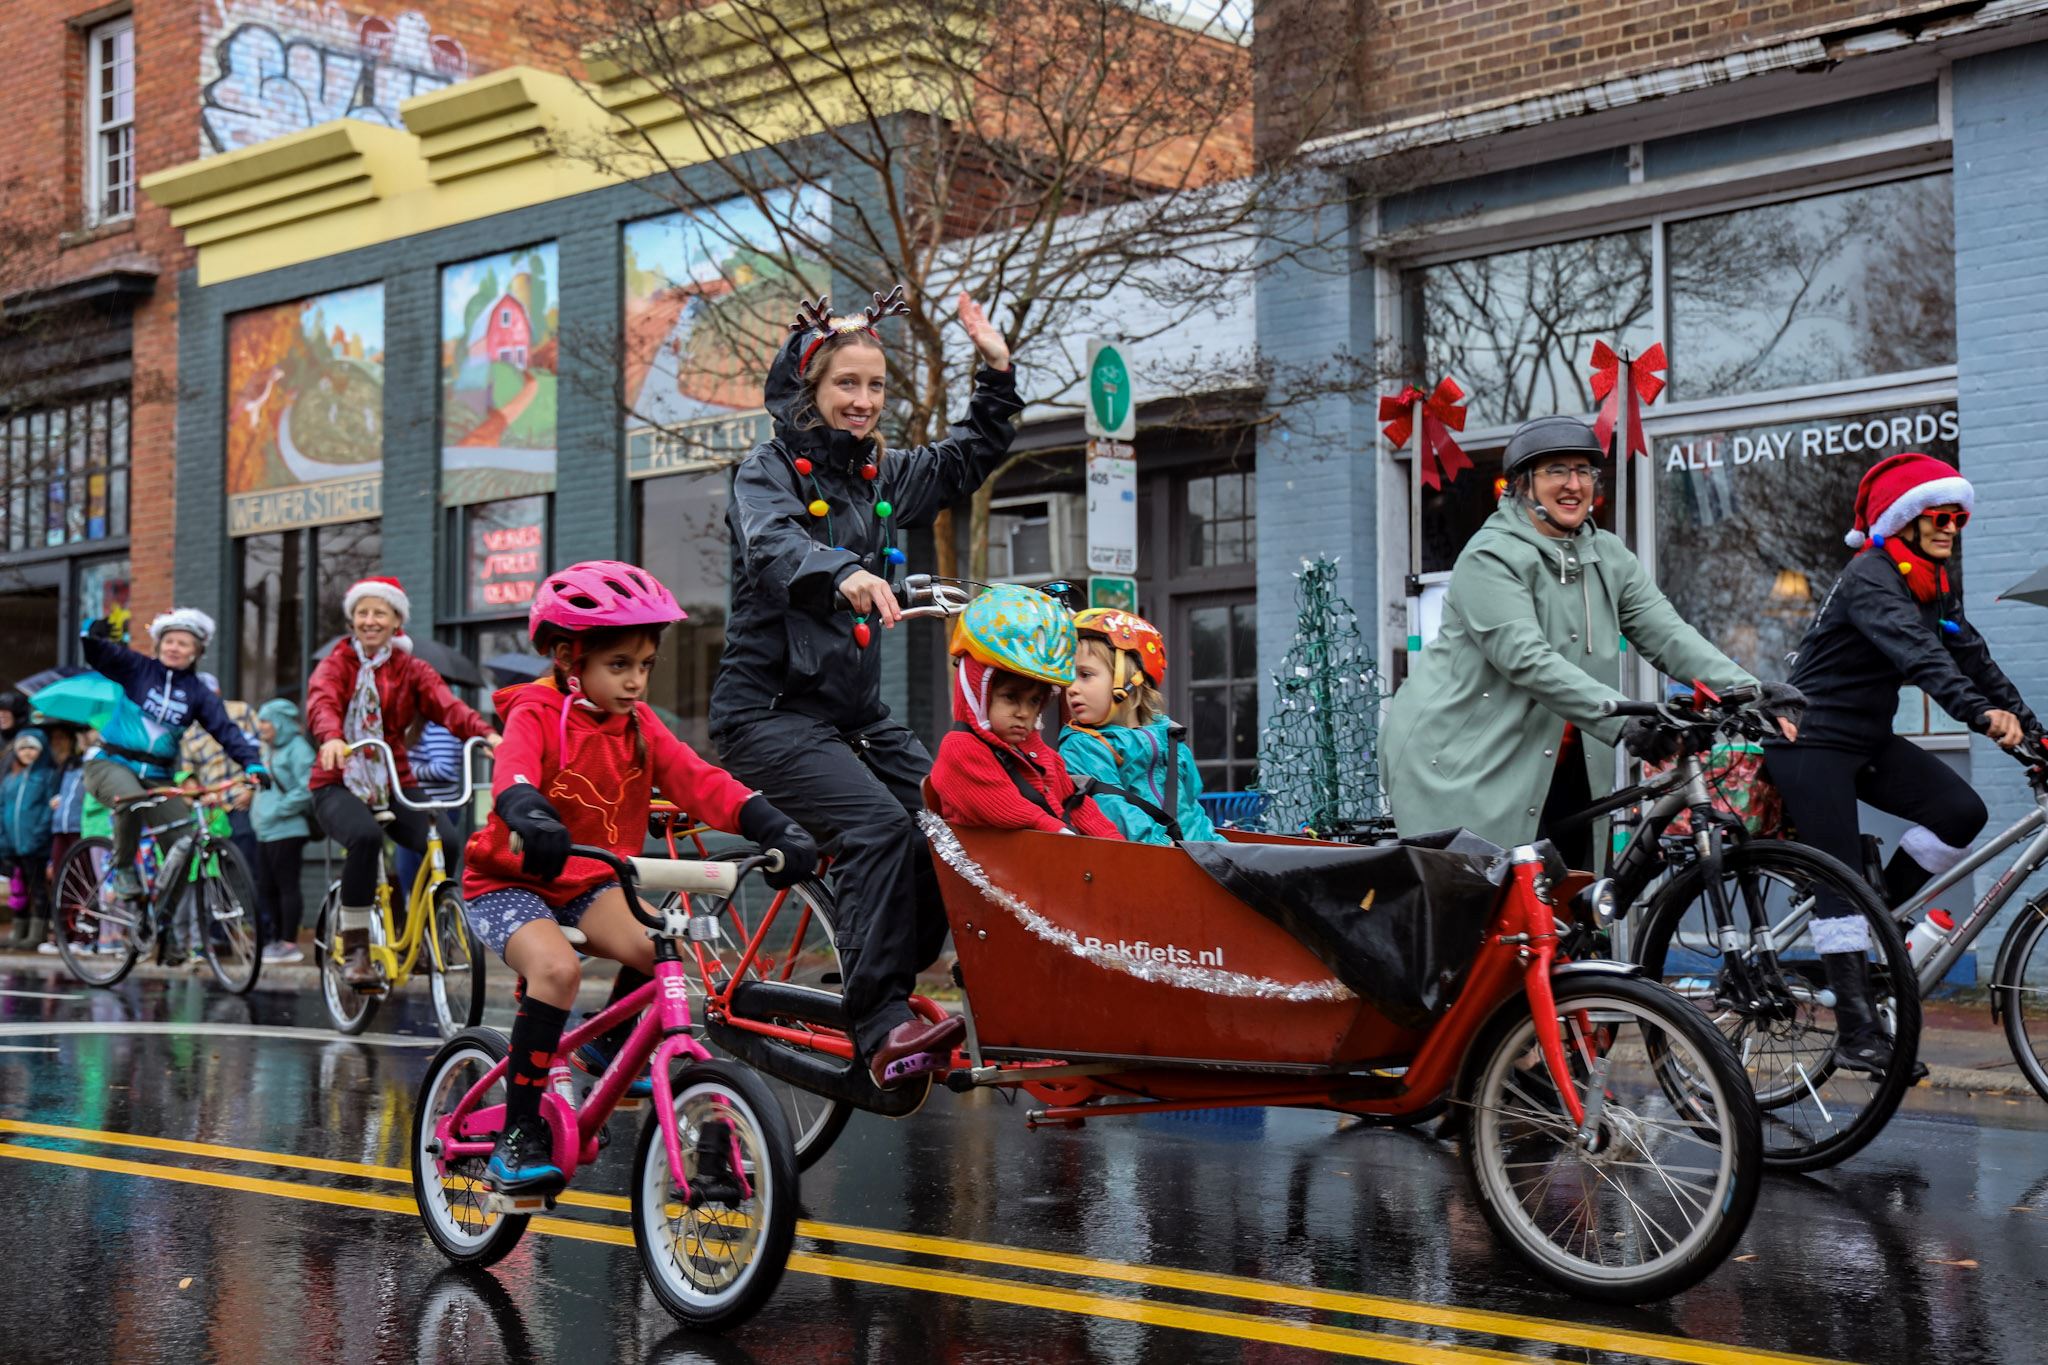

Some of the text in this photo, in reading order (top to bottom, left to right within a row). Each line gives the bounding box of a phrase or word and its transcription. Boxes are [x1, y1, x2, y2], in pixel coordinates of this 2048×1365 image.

[1666, 410, 1959, 472] ALL DAY RECORDS
[1090, 472, 1109, 485] 405
[232, 480, 382, 531] WEAVER STREET
[480, 552, 538, 580] STREET
[1084, 937, 1224, 967] Bakfiets.nl
